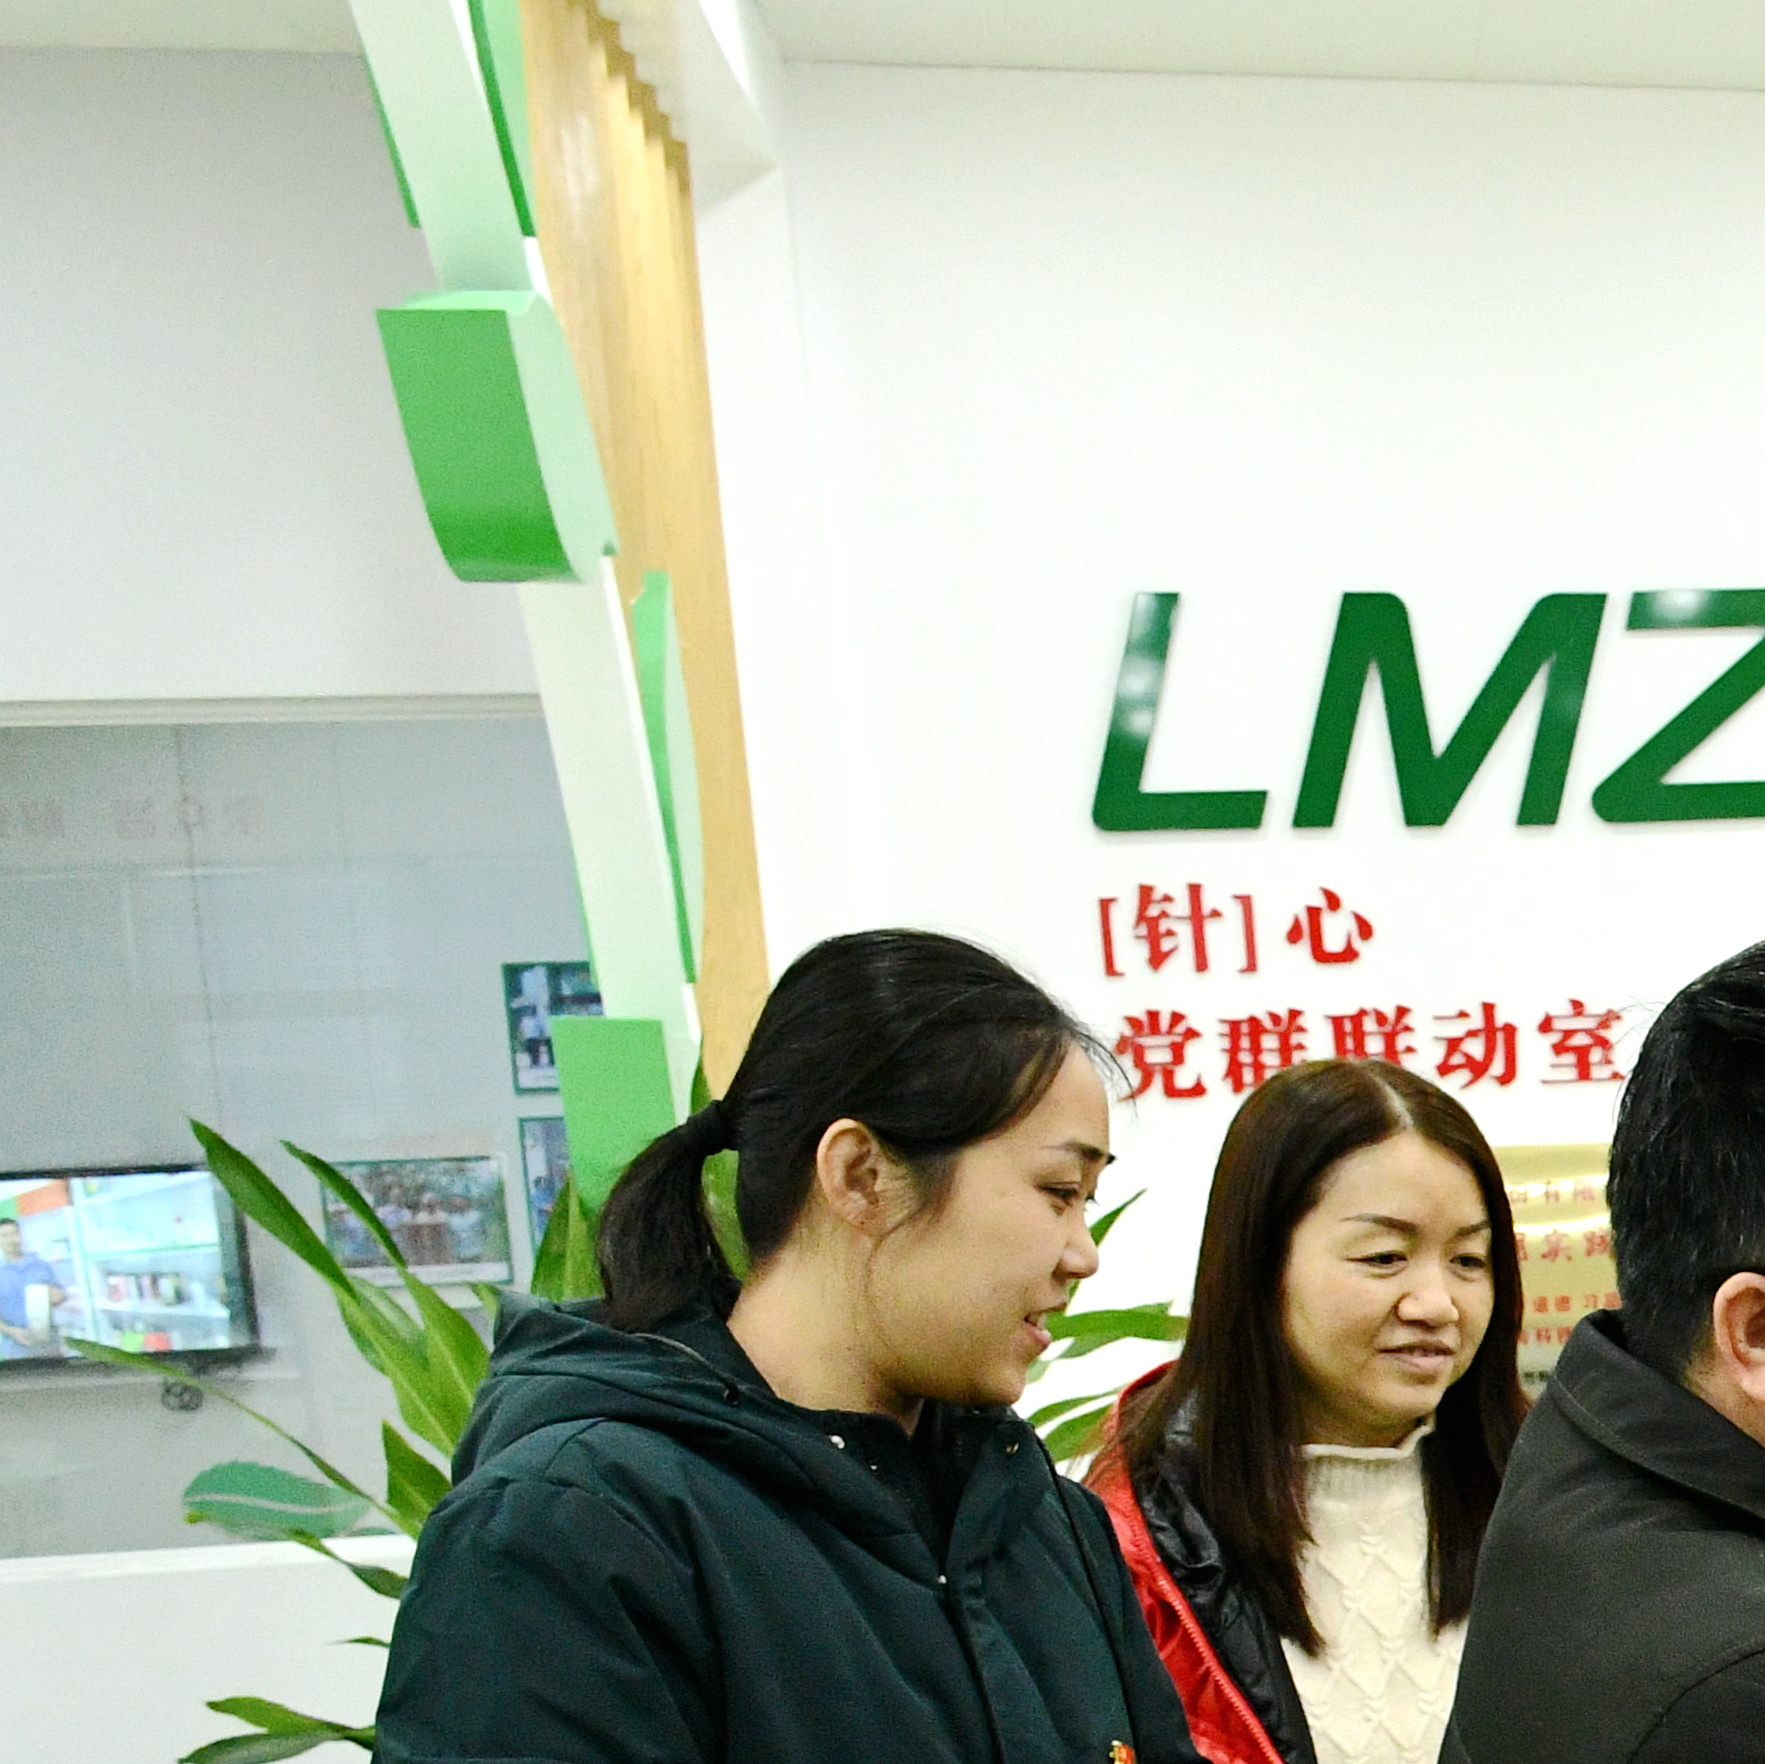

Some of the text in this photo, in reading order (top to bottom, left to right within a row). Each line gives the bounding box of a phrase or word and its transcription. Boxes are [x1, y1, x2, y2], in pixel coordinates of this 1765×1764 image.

[1115, 1000, 1629, 1100] 党群联动室
